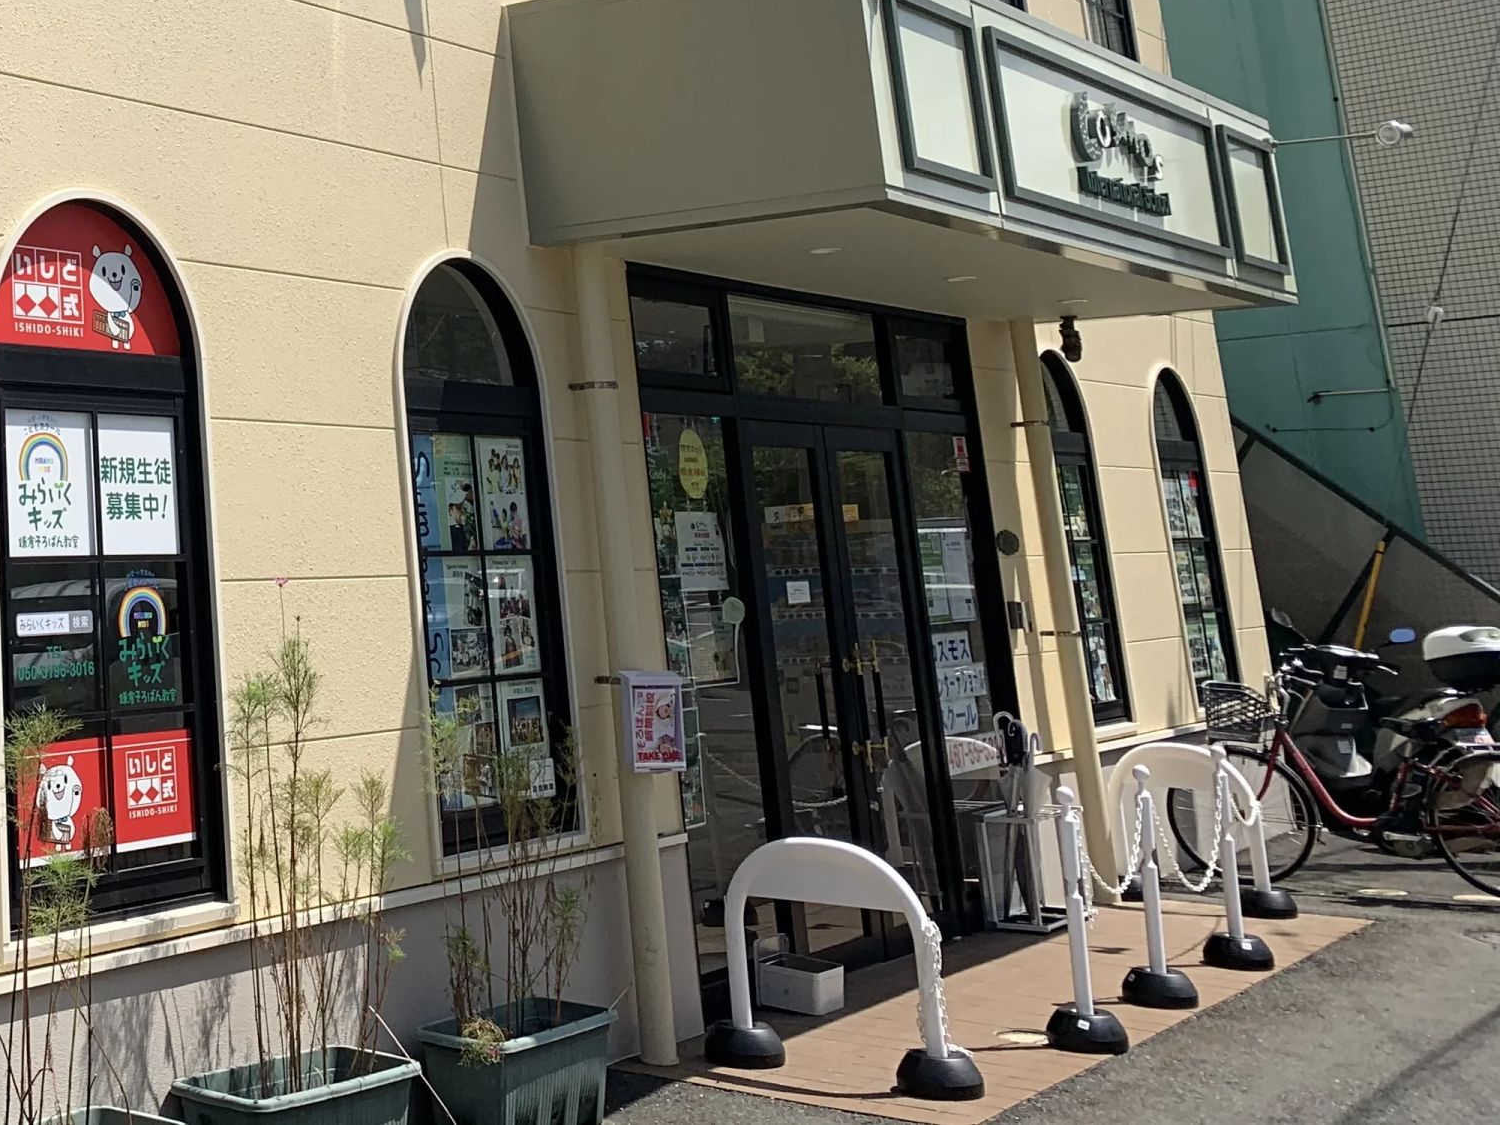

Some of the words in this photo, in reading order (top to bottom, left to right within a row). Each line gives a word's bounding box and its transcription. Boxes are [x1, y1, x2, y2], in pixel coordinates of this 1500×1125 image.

[15, 253, 78, 283] いしど
[14, 322, 84, 338] ISHIDO-SHIKI
[101, 456, 171, 484] 新規生徒
[18, 478, 72, 505] みらいく
[106, 493, 167, 520] 募集中!
[28, 507, 67, 531] キッズ
[19, 618, 65, 632] みらいくキッズ
[72, 616, 90, 629] 検索
[46, 645, 63, 660] TEL
[118, 633, 171, 662] みらいく
[127, 662, 165, 686] キッズ
[128, 751, 172, 773] いしど
[638, 752, 660, 761] TAKE
[129, 805, 178, 819] ISHIDO-SHIKI
